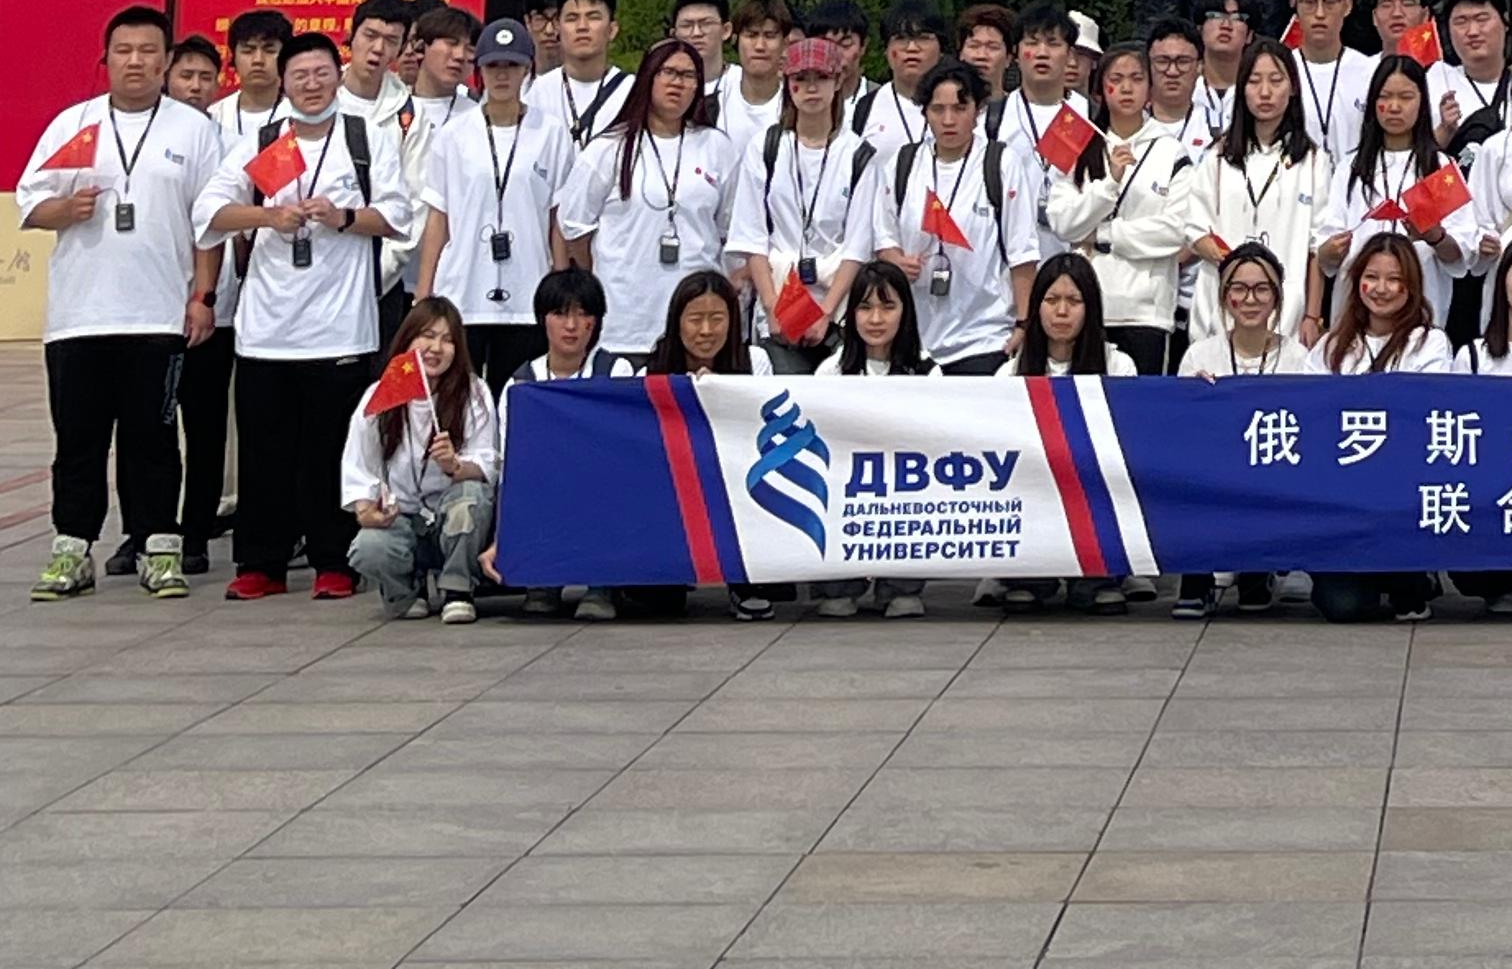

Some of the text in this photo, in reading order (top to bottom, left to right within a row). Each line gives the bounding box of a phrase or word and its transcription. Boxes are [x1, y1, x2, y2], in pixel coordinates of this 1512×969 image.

[844, 450, 1021, 498] ДВФУ
[843, 498, 1022, 517] ДАЛЬНЕВОСТОЧНЫЙ
[842, 514, 1022, 539] ФЕДЕРАЛЬНЫЙ
[842, 540, 1020, 561] УНИВЕРСИТЕТ
